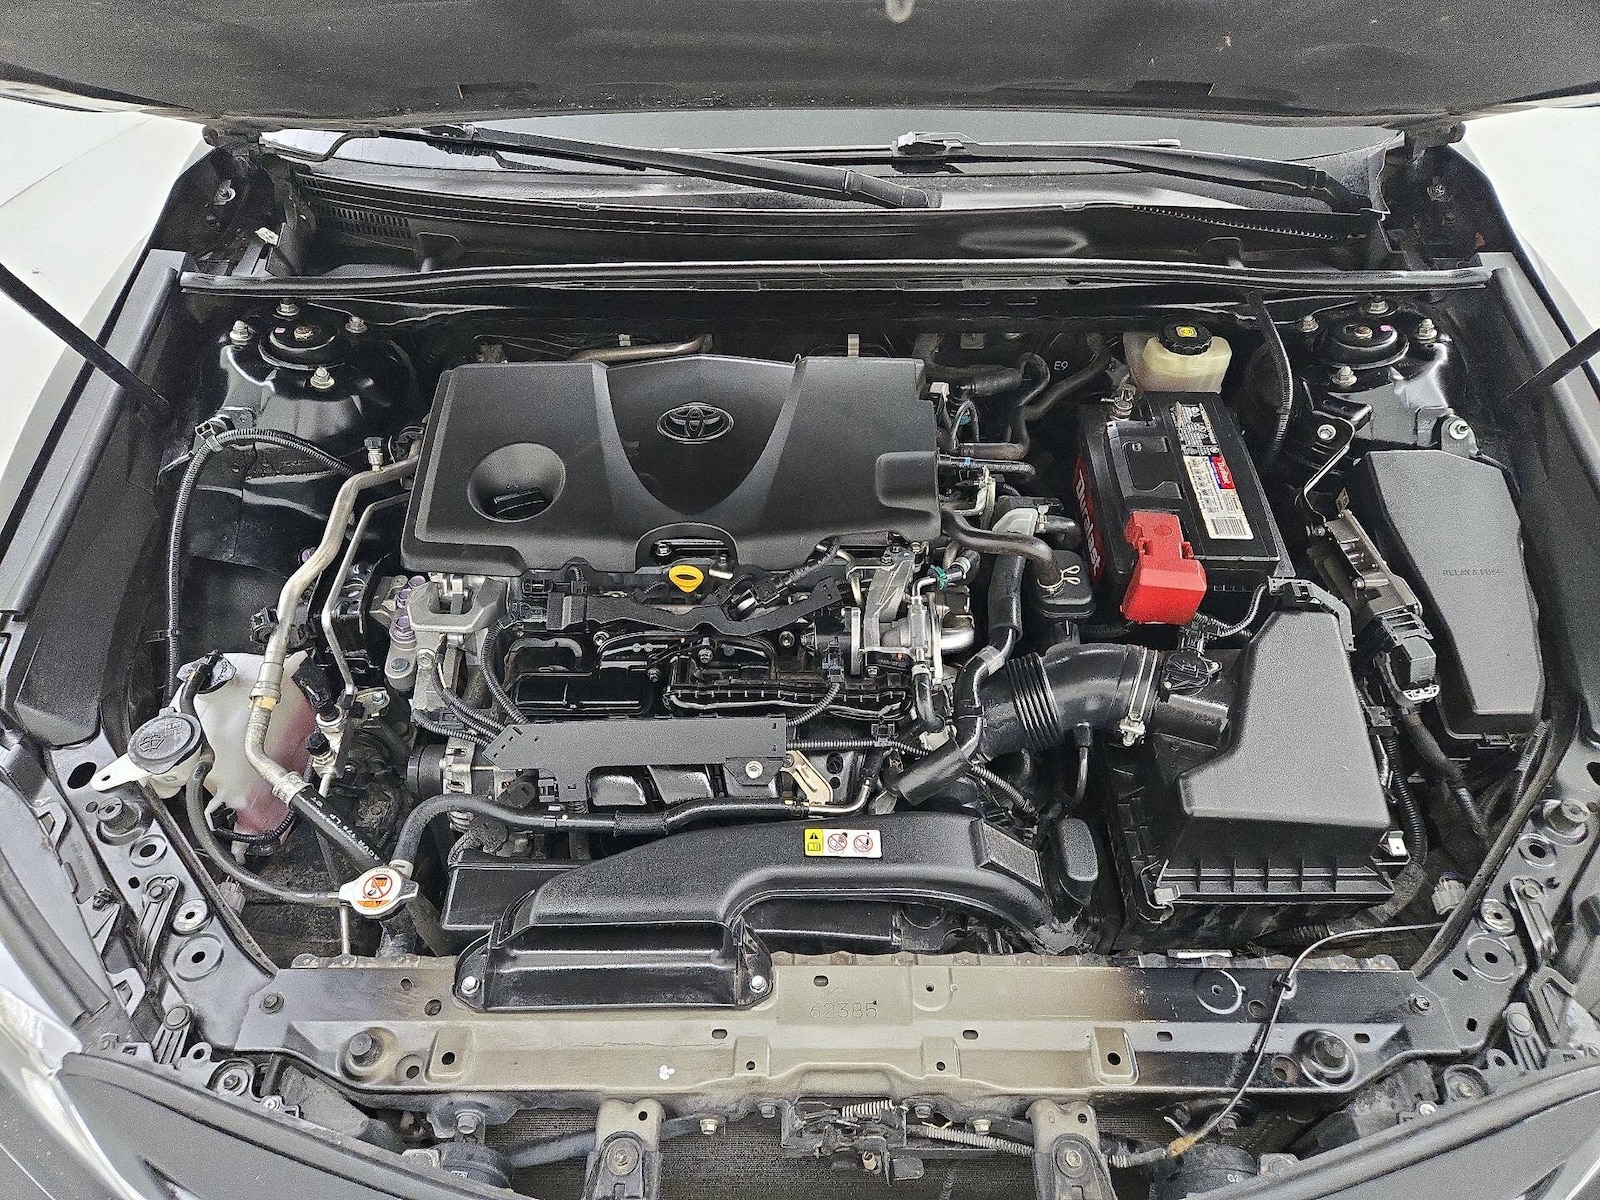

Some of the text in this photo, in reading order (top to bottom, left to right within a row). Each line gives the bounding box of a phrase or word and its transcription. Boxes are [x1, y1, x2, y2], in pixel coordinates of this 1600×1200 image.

[1053, 360, 1068, 372] E9
[1075, 469, 1101, 576] Duralast
[1442, 569, 1470, 577] RELAY
[810, 1001, 878, 1019] 62385
